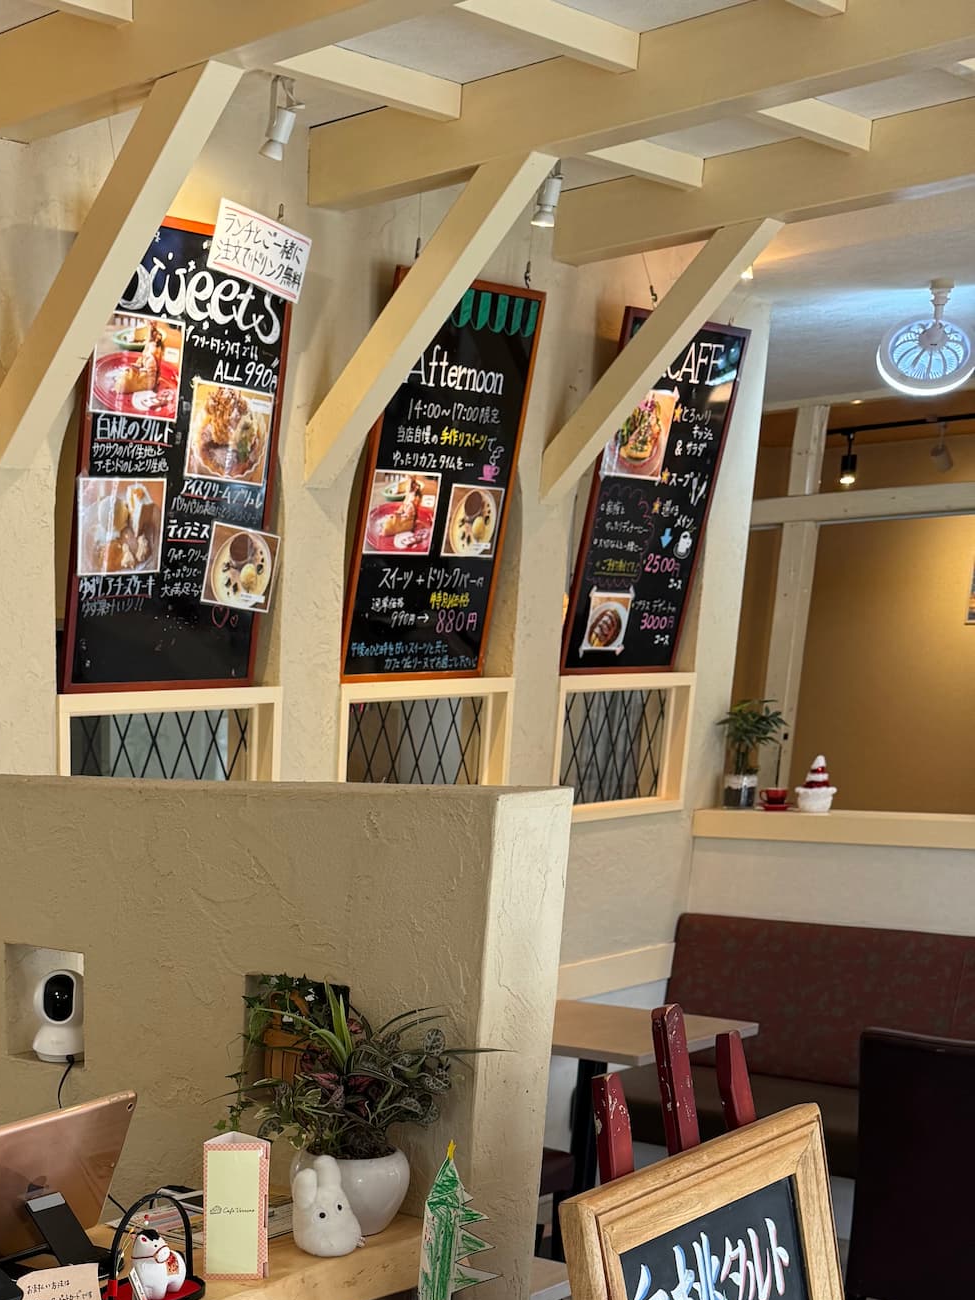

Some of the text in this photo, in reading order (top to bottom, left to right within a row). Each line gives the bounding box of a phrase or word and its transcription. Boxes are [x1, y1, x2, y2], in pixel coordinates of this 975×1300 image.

[224, 213, 304, 265] ランチとご一緒に
[213, 359, 243, 382] ALL
[96, 412, 174, 444] 白桃のタルト
[167, 519, 211, 539] ティラミス
[435, 609, 478, 634] 880円
[639, 612, 676, 631] 3000円
